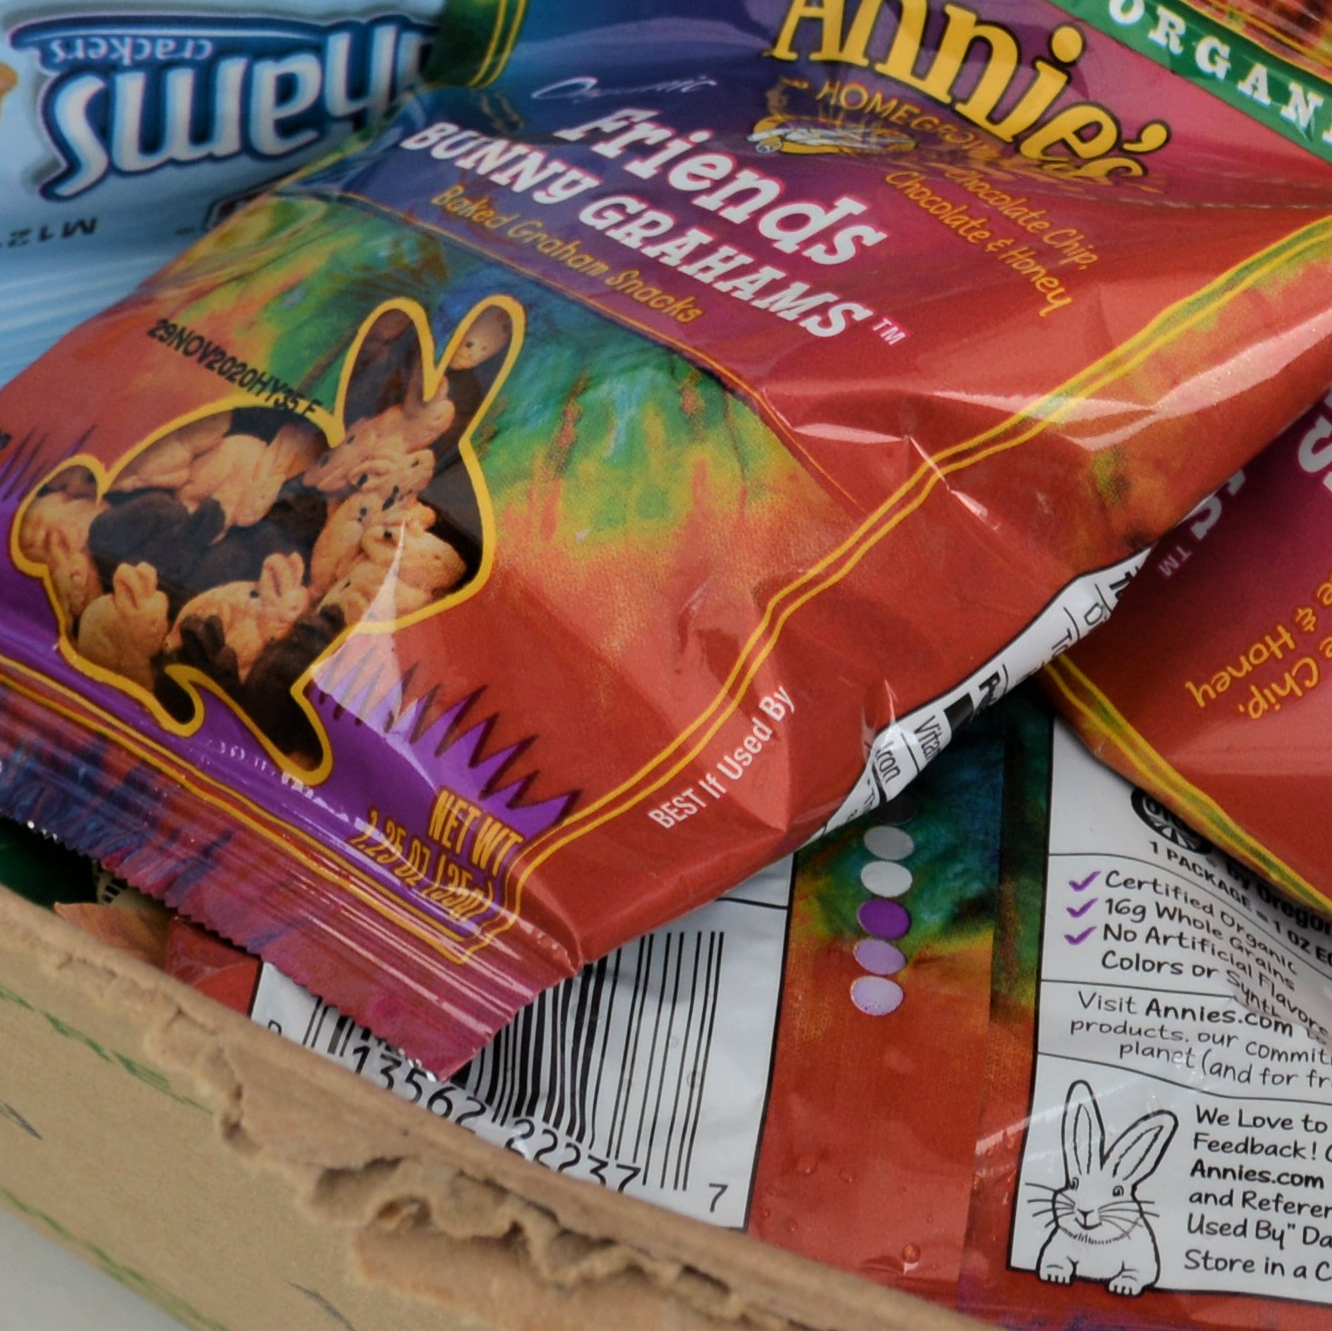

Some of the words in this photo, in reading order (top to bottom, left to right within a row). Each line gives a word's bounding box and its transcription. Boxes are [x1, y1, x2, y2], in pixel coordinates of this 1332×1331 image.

[47, 35, 213, 66] crackers
[553, 106, 890, 266] Friends
[399, 121, 603, 206] BUNNY
[578, 195, 875, 339] GRAHAMS
[430, 184, 510, 234] Baked
[508, 218, 611, 279] Graham
[603, 267, 703, 325] Snacks
[885, 171, 991, 244] Chocolate
[997, 244, 1074, 318] Honey
[1182, 622, 1298, 710] Honey
[1234, 656, 1321, 721] Chip,
[649, 787, 707, 831] BEST
[718, 722, 776, 782] Used
[760, 684, 796, 735] By
[429, 789, 483, 854] NET
[472, 816, 524, 877] WT
[1105, 869, 1220, 916] Certified
[1220, 911, 1299, 975] Organic
[1165, 846, 1252, 913] PACKAGE
[1287, 929, 1312, 955] OZ
[1100, 948, 1185, 976] Colors
[1190, 964, 1220, 980] or
[1102, 923, 1138, 943] No
[1144, 927, 1252, 979] Artificial
[1105, 897, 1147, 924] 16g
[1154, 900, 1224, 941] Whole
[1228, 936, 1296, 992] Grains
[1076, 990, 1139, 1015] Visit
[1144, 997, 1294, 1039] Annies.com
[1196, 1031, 1240, 1048] our
[1118, 1040, 1196, 1069] planet
[1200, 1047, 1253, 1085] (and
[1258, 1066, 1300, 1087] for
[352, 1045, 488, 1135] 13562
[706, 1181, 729, 1214] 7
[1195, 1102, 1231, 1128] We
[1236, 1107, 1296, 1132] Love
[1302, 1113, 1330, 1135] to
[1187, 1188, 1235, 1209] and
[1189, 1158, 1326, 1191] Annies.com
[1186, 1212, 1249, 1240] Used
[1183, 1248, 1257, 1275] Store
[1263, 1255, 1288, 1279] in
[1292, 1265, 1309, 1280] a
